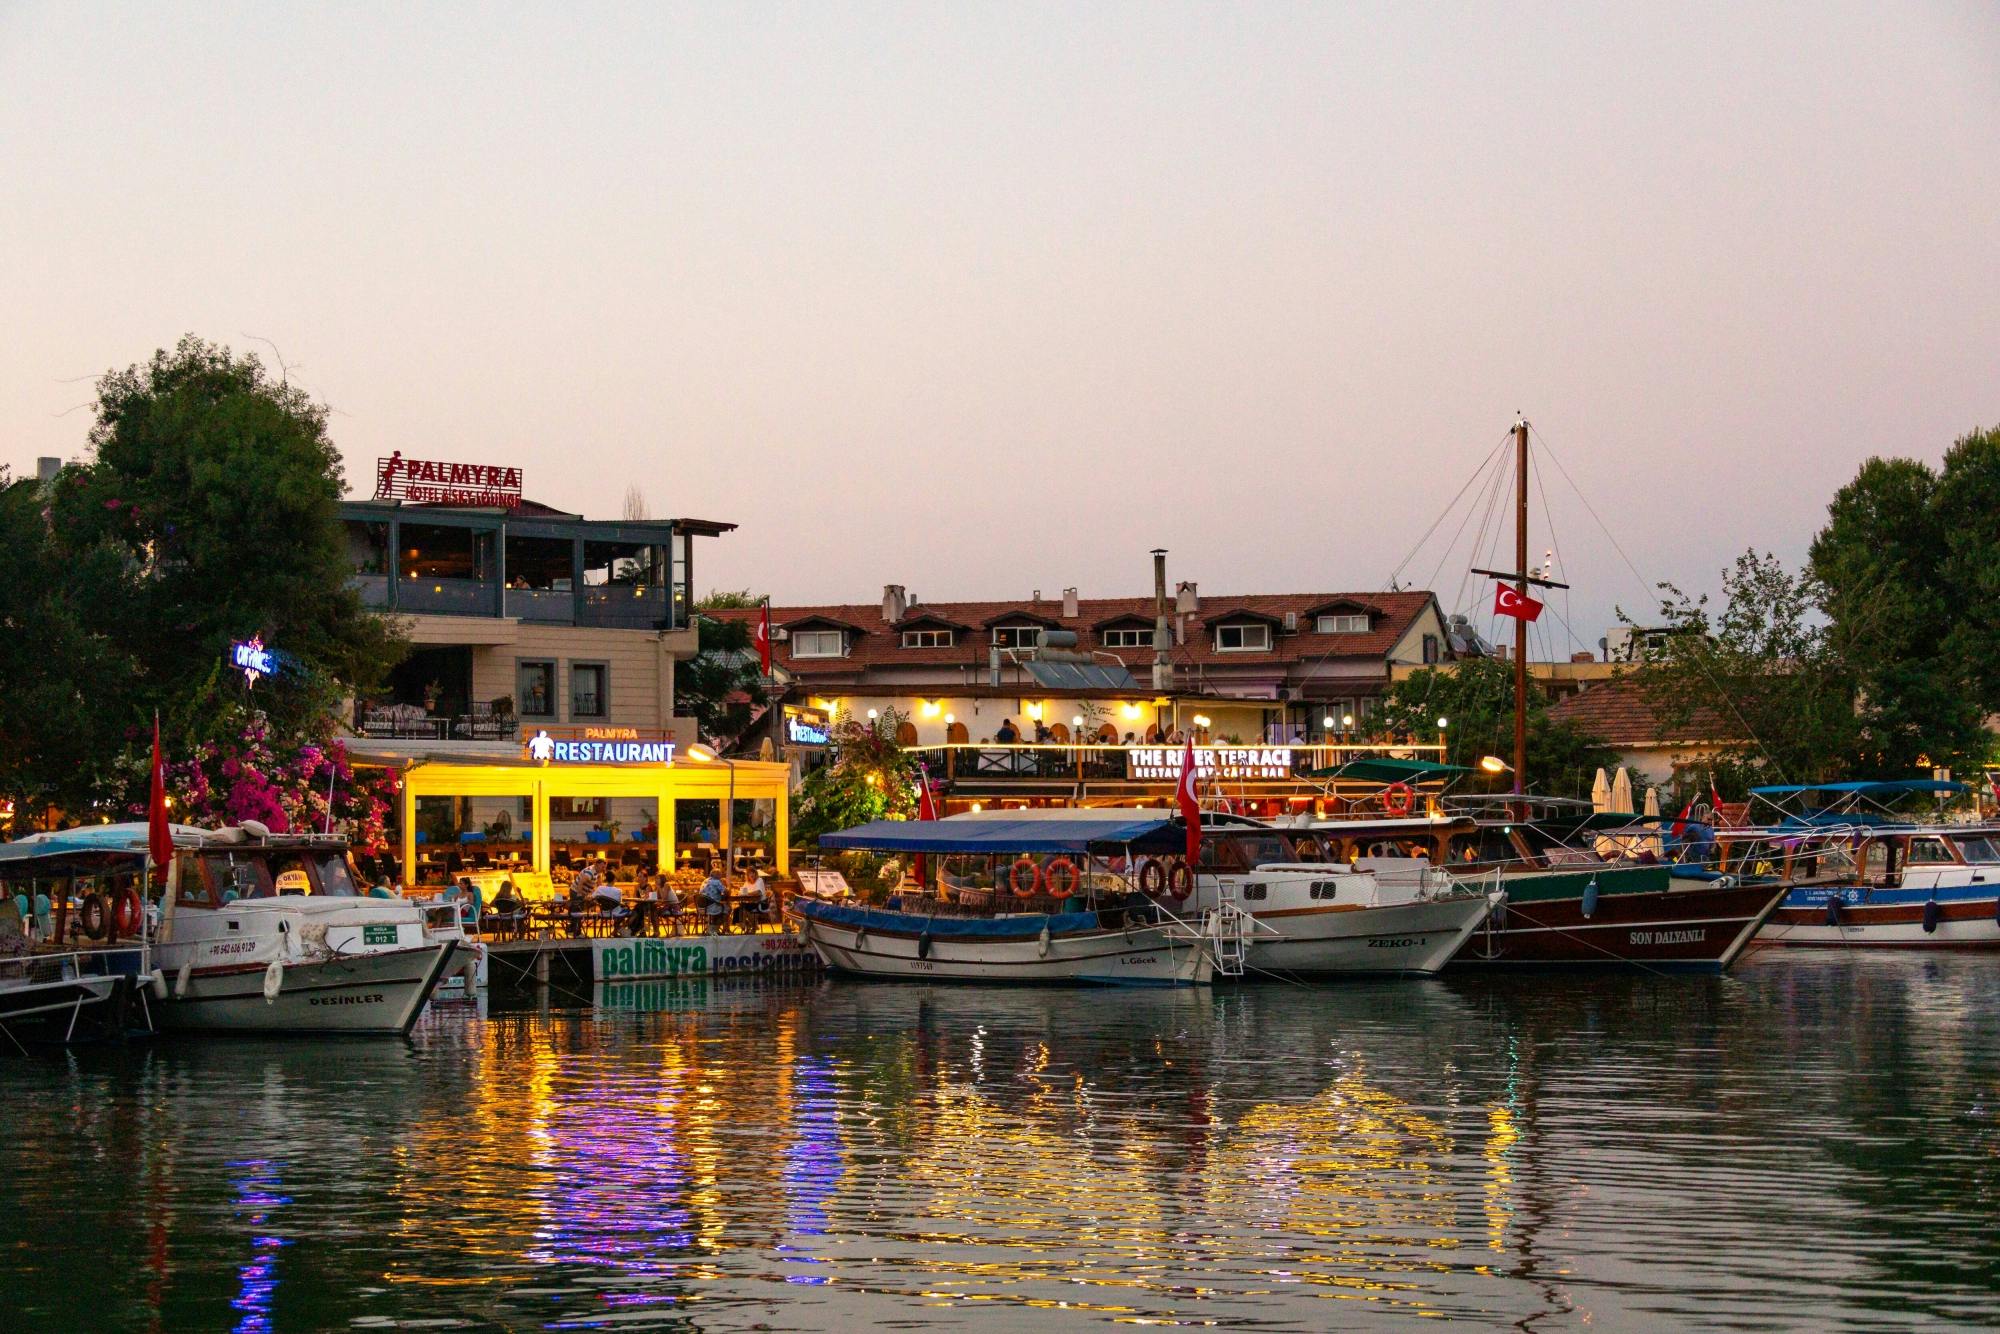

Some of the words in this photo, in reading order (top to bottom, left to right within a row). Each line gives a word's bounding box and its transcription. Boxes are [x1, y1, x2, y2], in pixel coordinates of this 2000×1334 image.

[407, 460, 518, 488] PALMYRA
[405, 486, 439, 501] HOTEL
[476, 491, 521, 508] LOUNGE
[585, 728, 638, 739] PALMYRA
[555, 742, 676, 763] RESTAURANT
[1129, 749, 1162, 766] THE
[1218, 749, 1291, 766] TERRACE
[1135, 767, 1214, 778] RESTAUNT
[1261, 767, 1284, 778] BAR
[1630, 932, 1653, 944] SON
[1654, 929, 1706, 944] DALYANLI
[602, 941, 707, 979] palmyra
